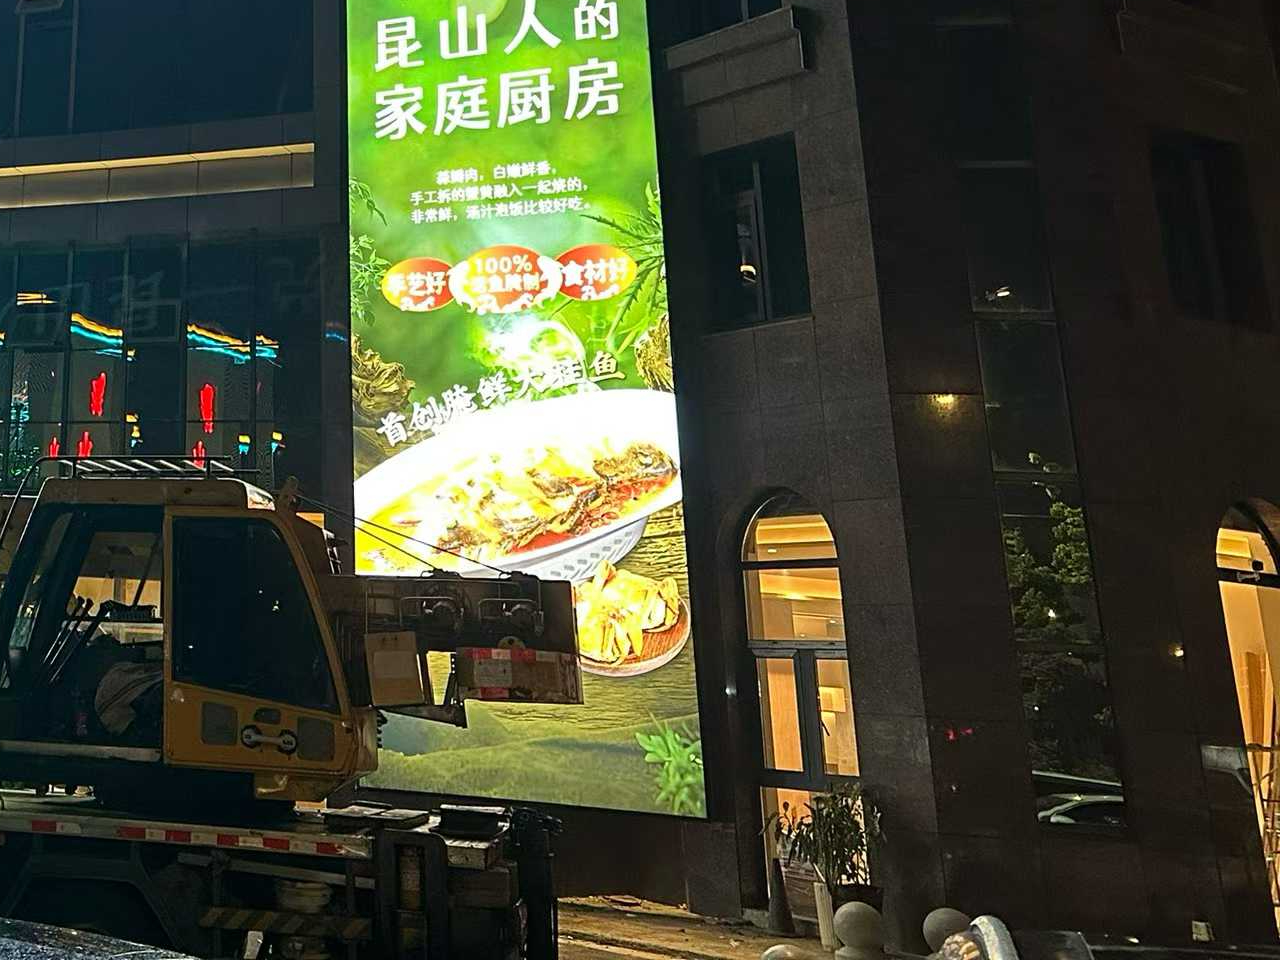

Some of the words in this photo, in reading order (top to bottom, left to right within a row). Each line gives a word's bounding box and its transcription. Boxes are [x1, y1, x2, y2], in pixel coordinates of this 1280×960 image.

[374, 57, 624, 141] 家庭厨房
[475, 254, 533, 273] 100%
